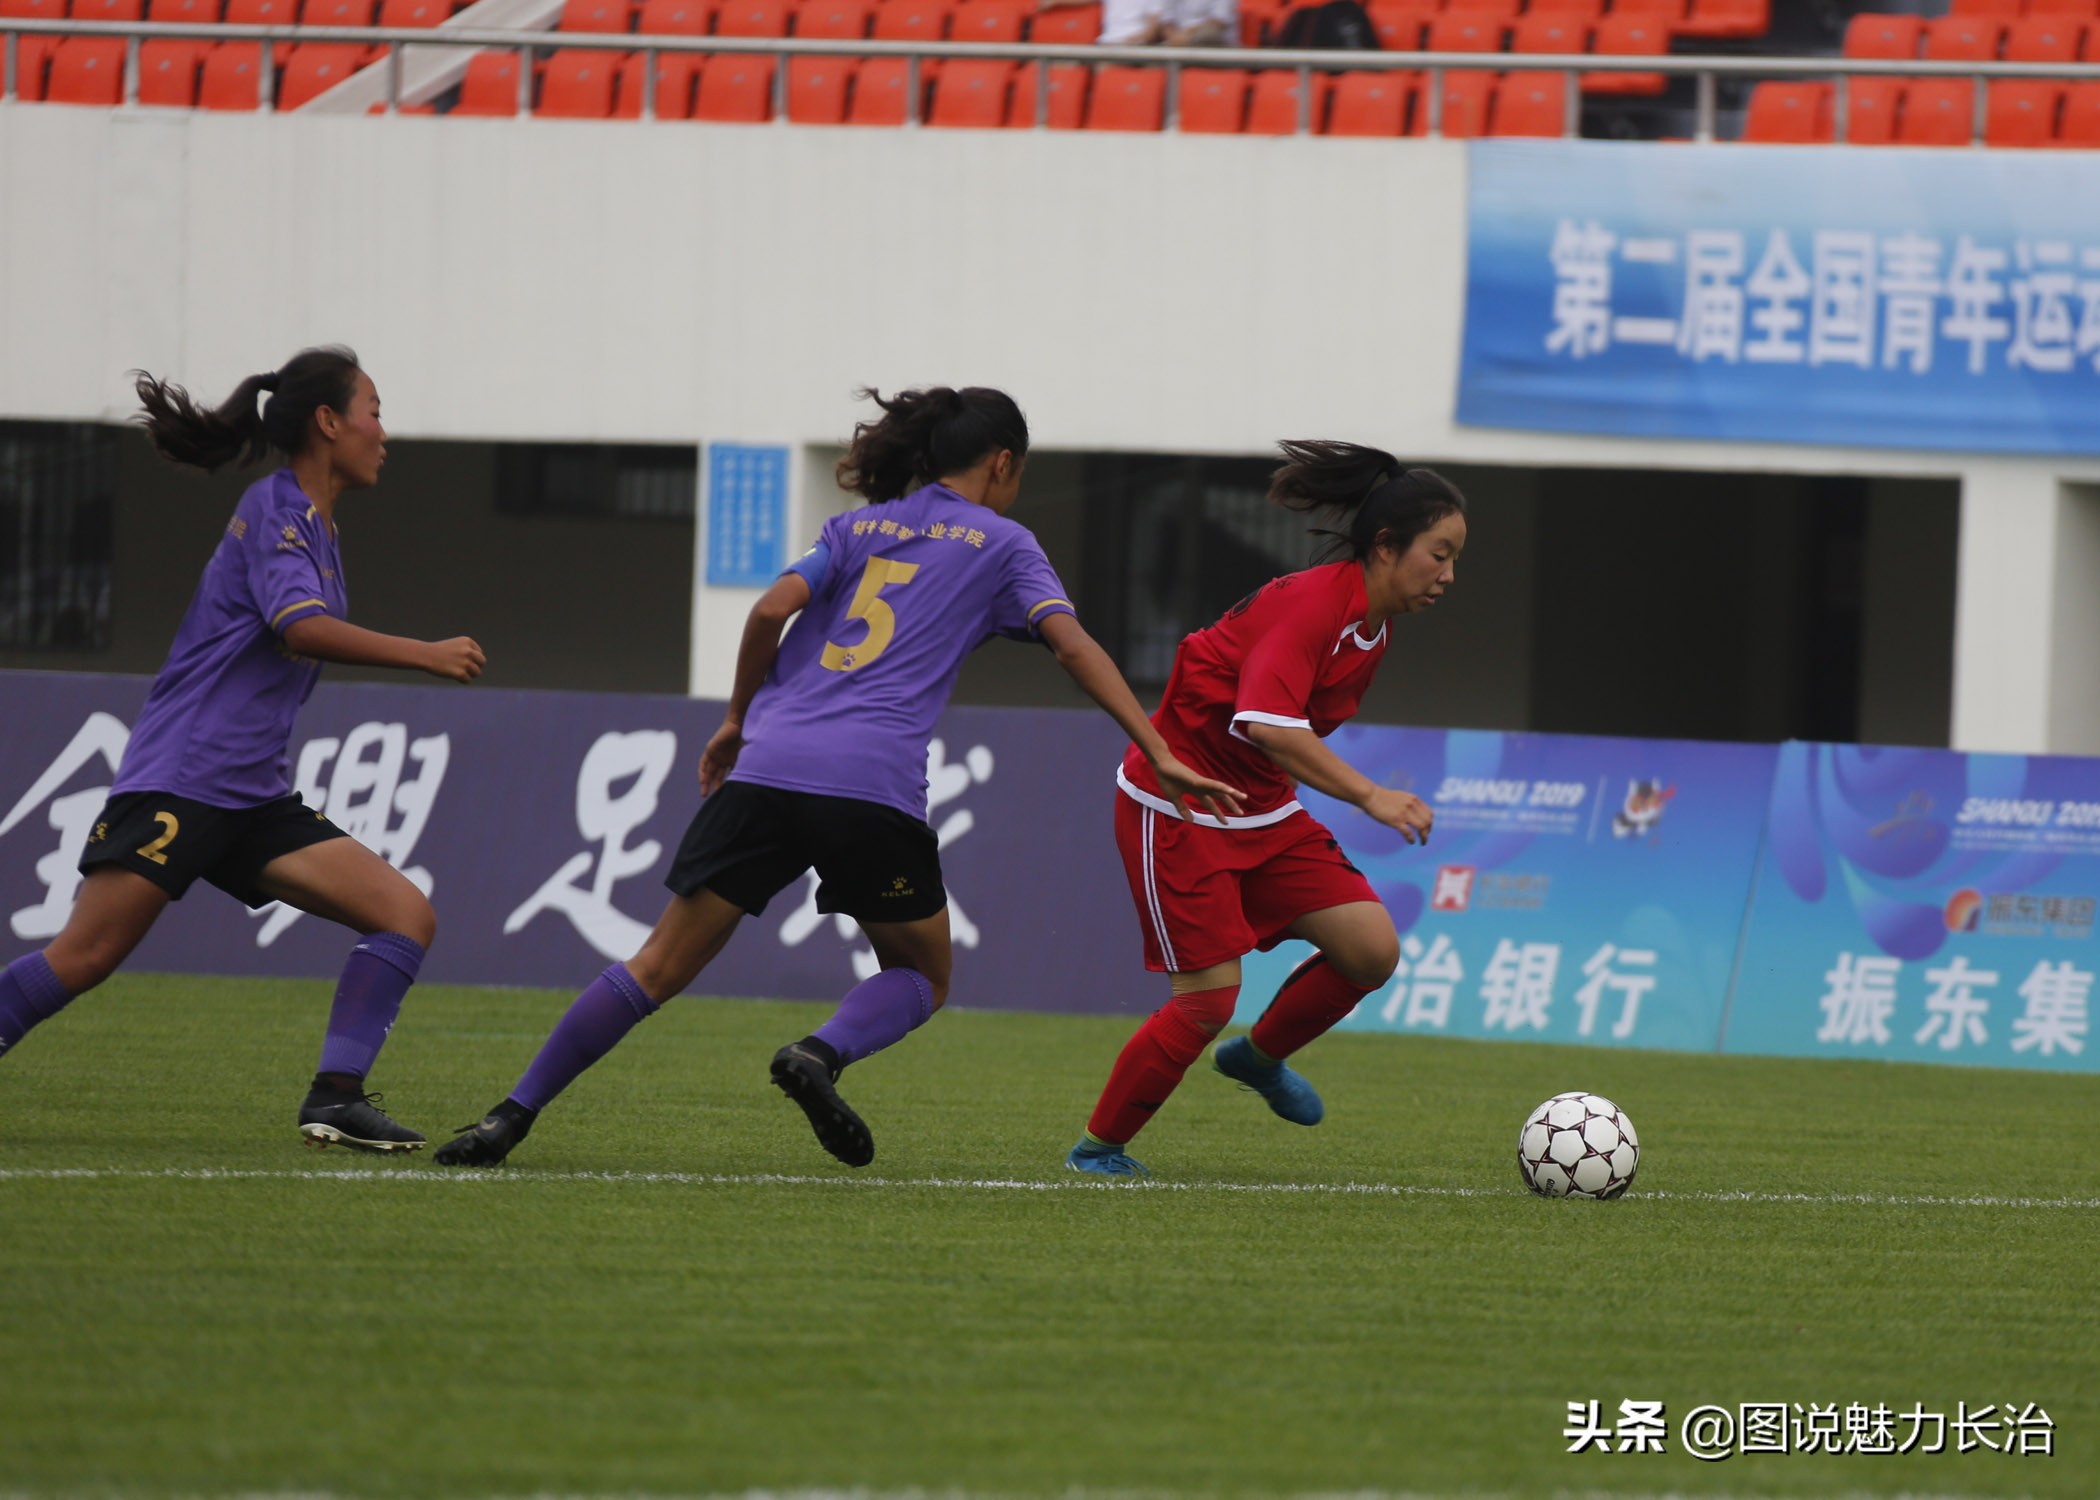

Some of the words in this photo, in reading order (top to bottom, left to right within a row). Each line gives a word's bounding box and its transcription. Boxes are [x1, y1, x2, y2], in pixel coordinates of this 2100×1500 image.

[819, 555, 920, 672] 5
[1528, 781, 1586, 807] 2019
[2055, 801, 2100, 828] 201
[136, 811, 179, 865] 2
[1345, 934, 1657, 1040] 治银行
[1816, 951, 2095, 1057] 振东集
